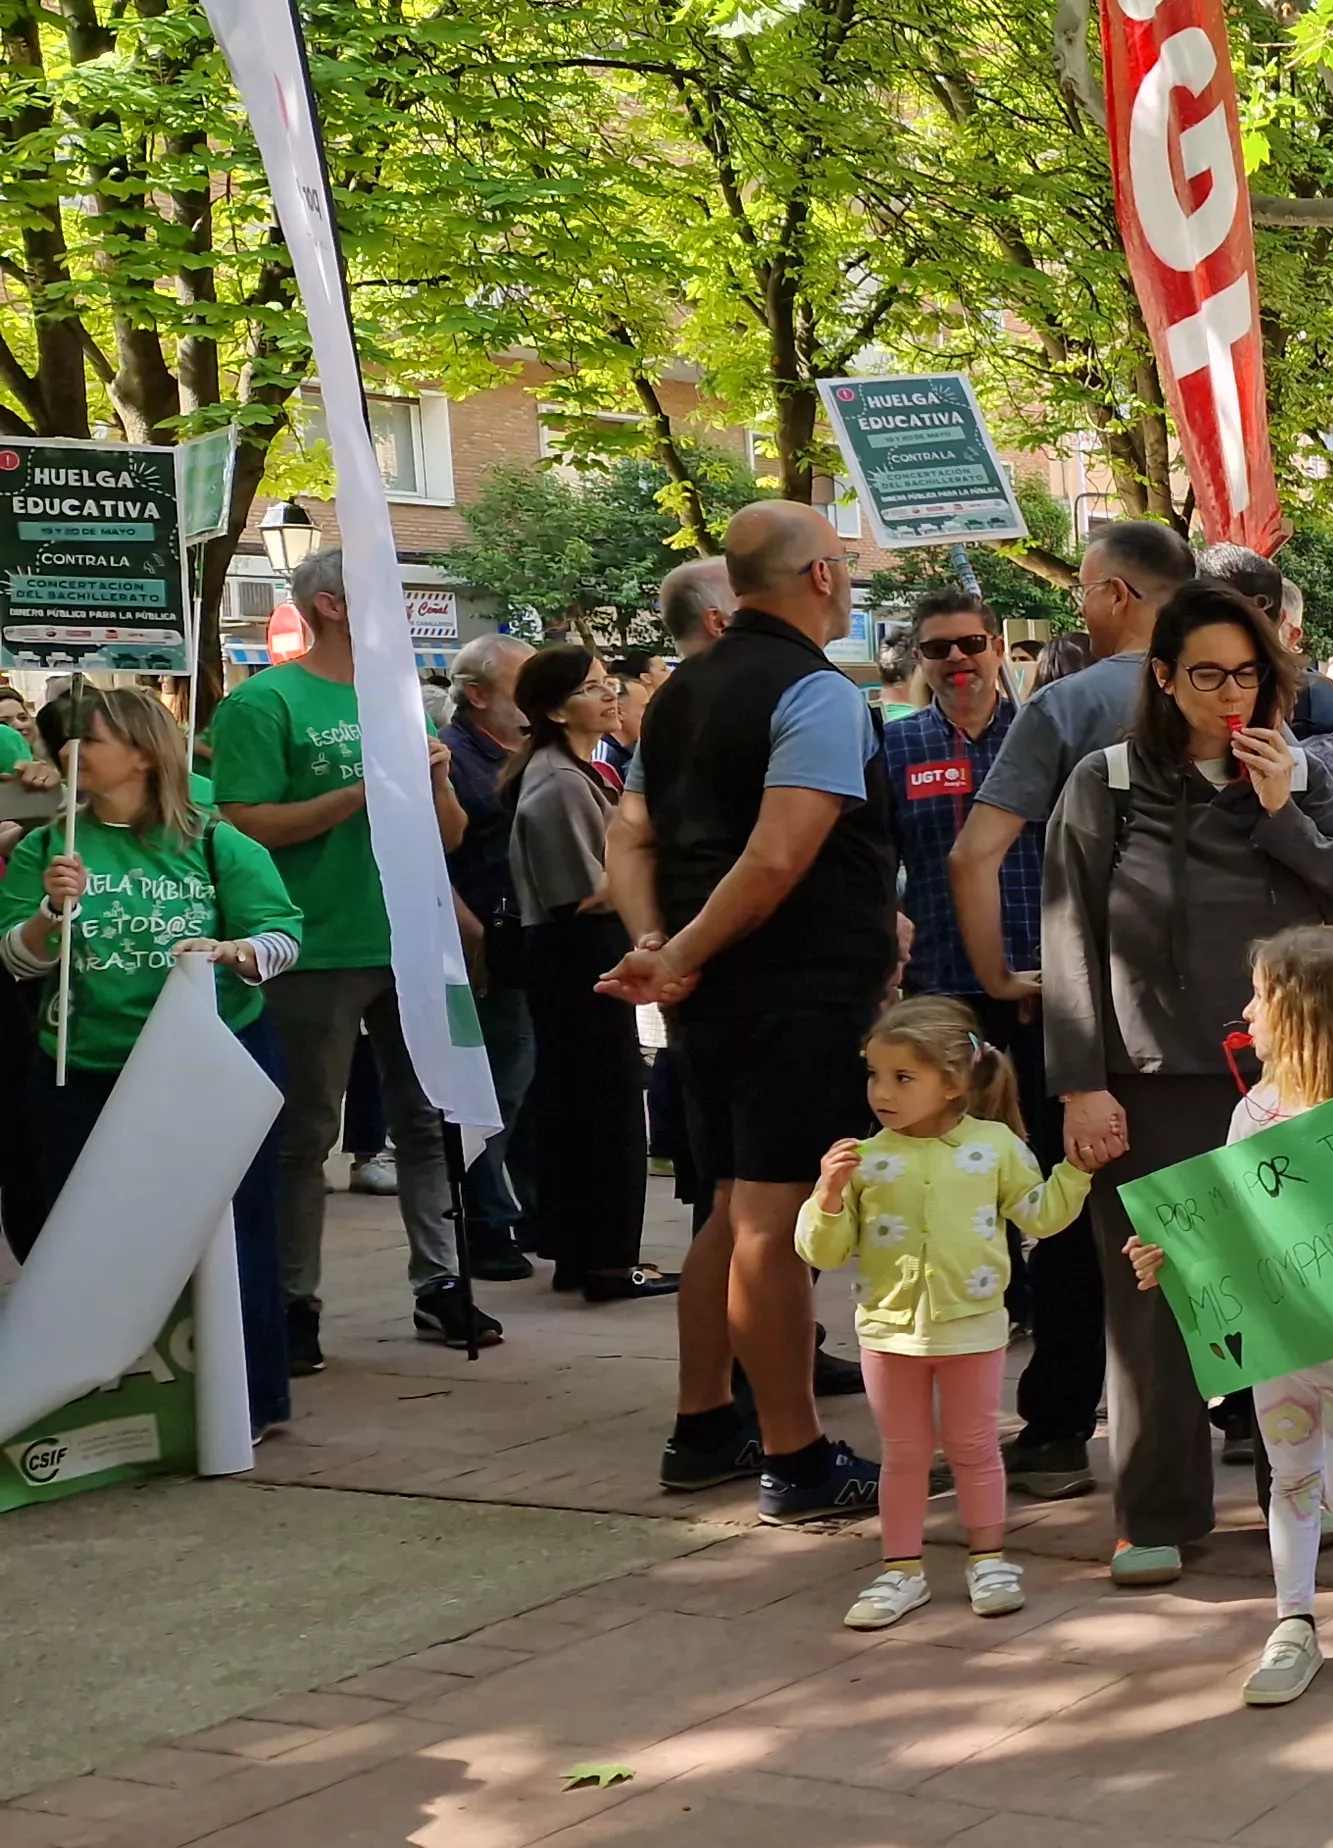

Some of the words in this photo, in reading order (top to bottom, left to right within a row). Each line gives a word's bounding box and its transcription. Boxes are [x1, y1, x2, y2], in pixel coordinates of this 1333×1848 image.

[867, 391, 941, 409] HUELGA
[857, 411, 964, 431] EDUCATIVA
[927, 431, 951, 439] MAYO
[891, 452, 940, 463] CONTRA
[940, 450, 956, 460] LA
[34, 467, 134, 488] HUELGA
[882, 480, 903, 490] DEL
[904, 475, 983, 487] BACHILLERATO
[959, 488, 969, 496] LA
[12, 496, 161, 519] EDUCATIVA
[101, 528, 136, 536] MAYO
[41, 553, 107, 566] CONTRA
[110, 555, 130, 567] LA
[16, 590, 44, 599] DEL
[48, 592, 160, 602] BACHILLERATO
[9, 607, 44, 617] DINERO
[47, 608, 87, 618] PÚBLICO
[89, 610, 117, 619] PARA
[119, 611, 133, 619] LA
[135, 610, 177, 621] PÚBLICA
[911, 769, 944, 786] UGT
[139, 873, 217, 902] PÚBLICA
[81, 921, 100, 939] E
[112, 915, 202, 938] TOD@S
[1156, 1198, 1209, 1238] POR
[1242, 1154, 1310, 1198] POR
[1188, 1275, 1244, 1336] MIS
[29, 1447, 68, 1471] CSIF
